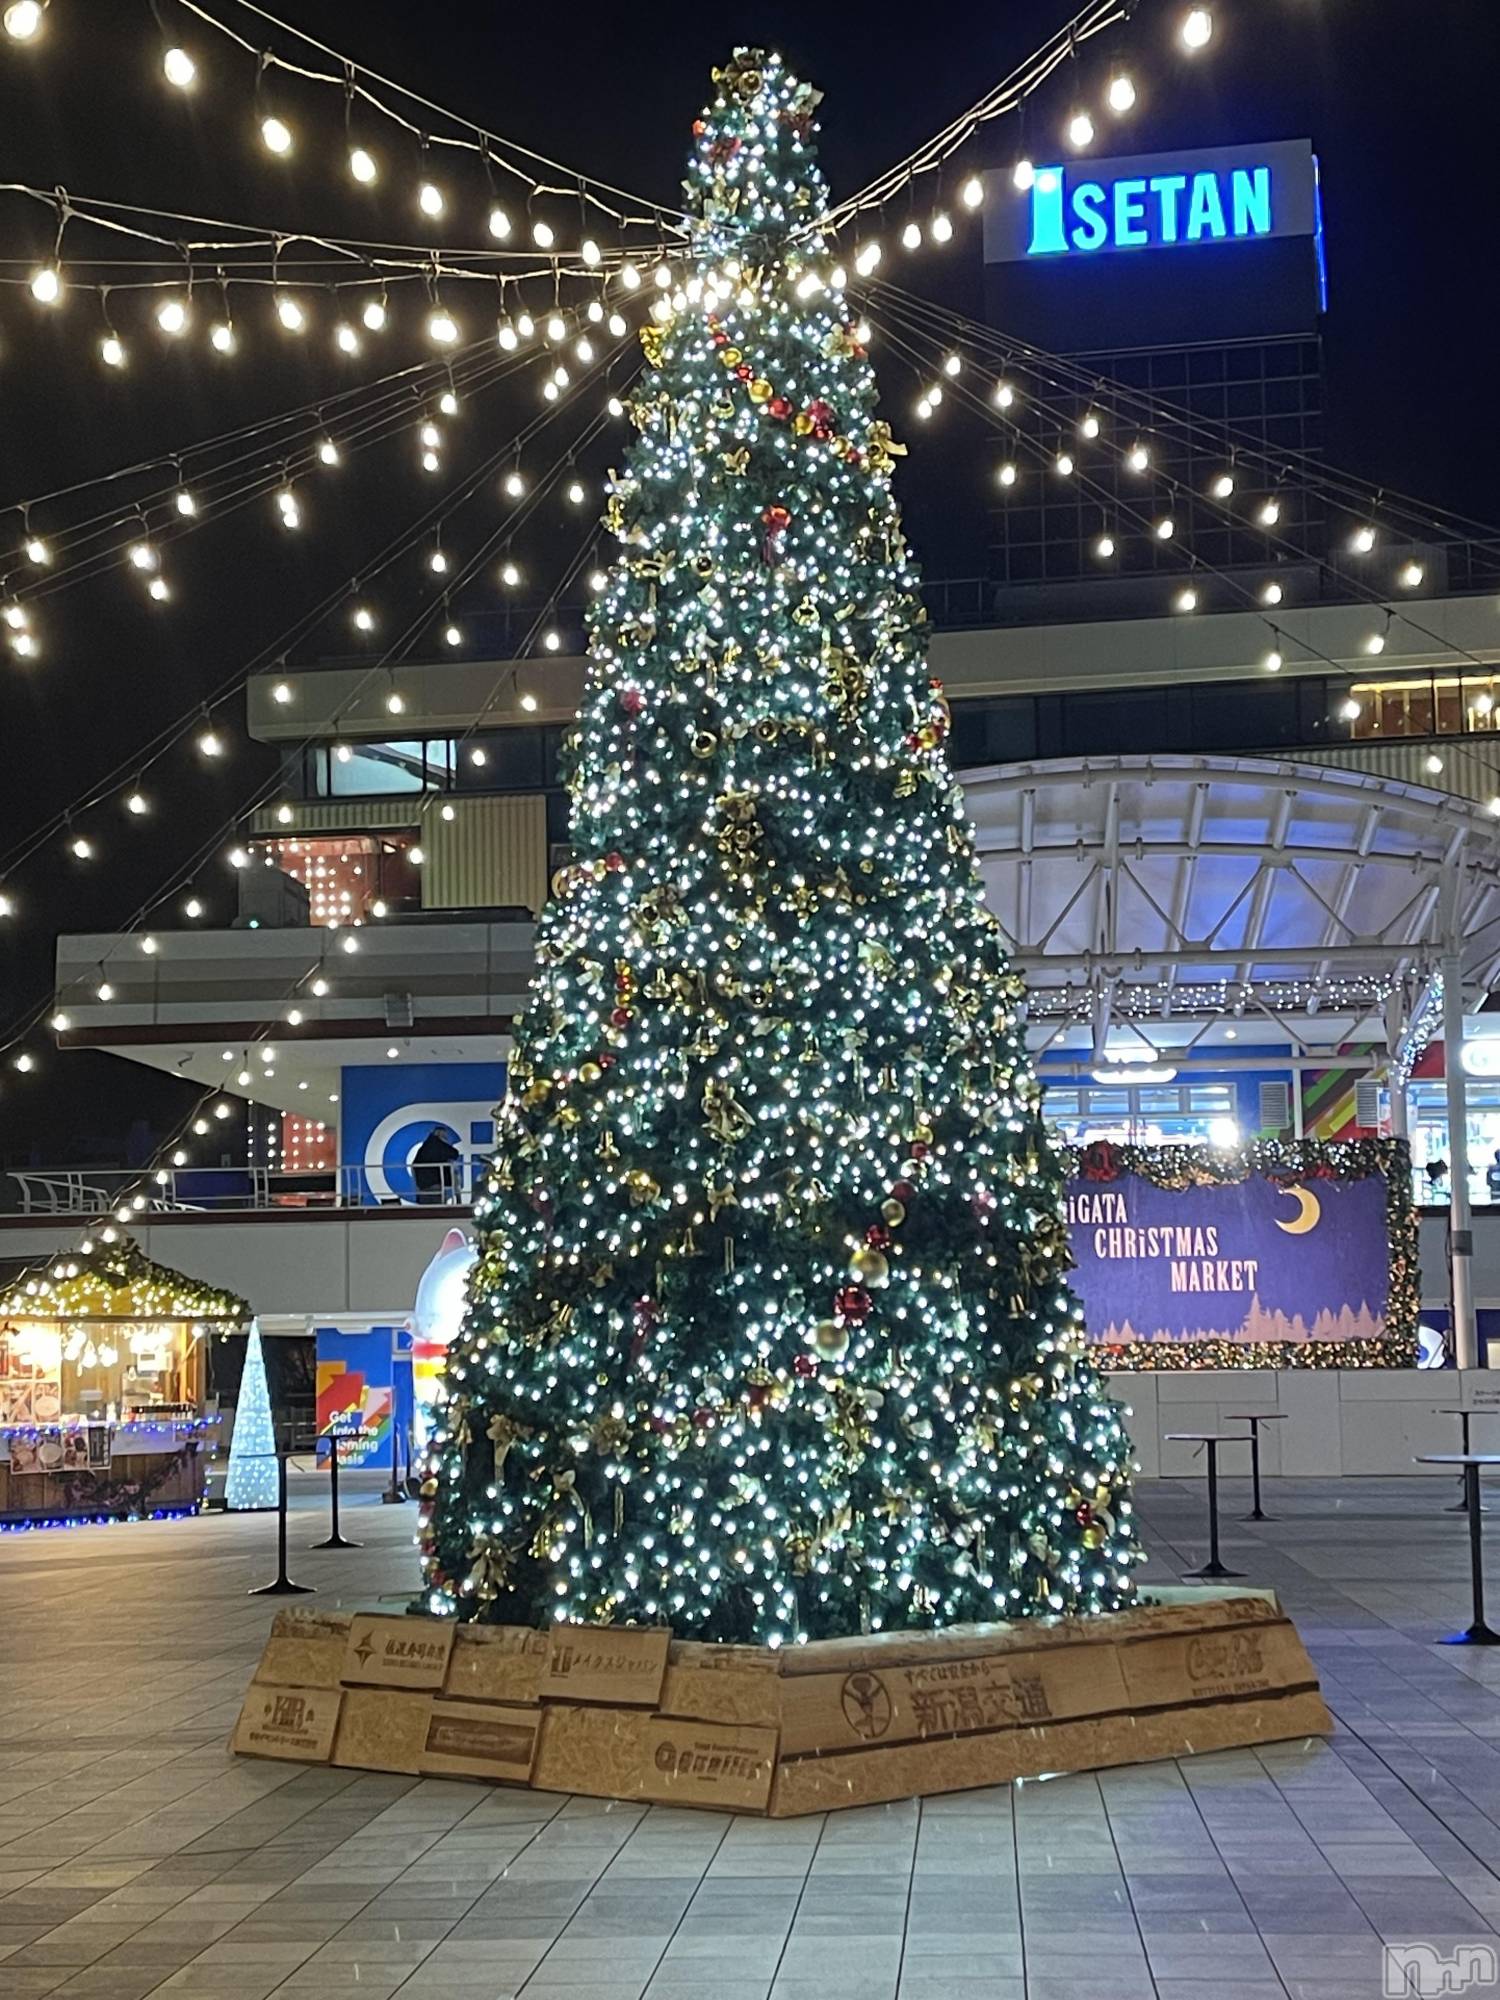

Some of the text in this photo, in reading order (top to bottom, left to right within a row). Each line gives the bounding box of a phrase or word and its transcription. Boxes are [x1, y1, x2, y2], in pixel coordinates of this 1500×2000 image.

[1027, 166, 1271, 255] ISETAN
[1170, 1260, 1258, 1293] MARKET
[329, 1411, 352, 1424] Get
[911, 1676, 1054, 1731] 新潟交通
